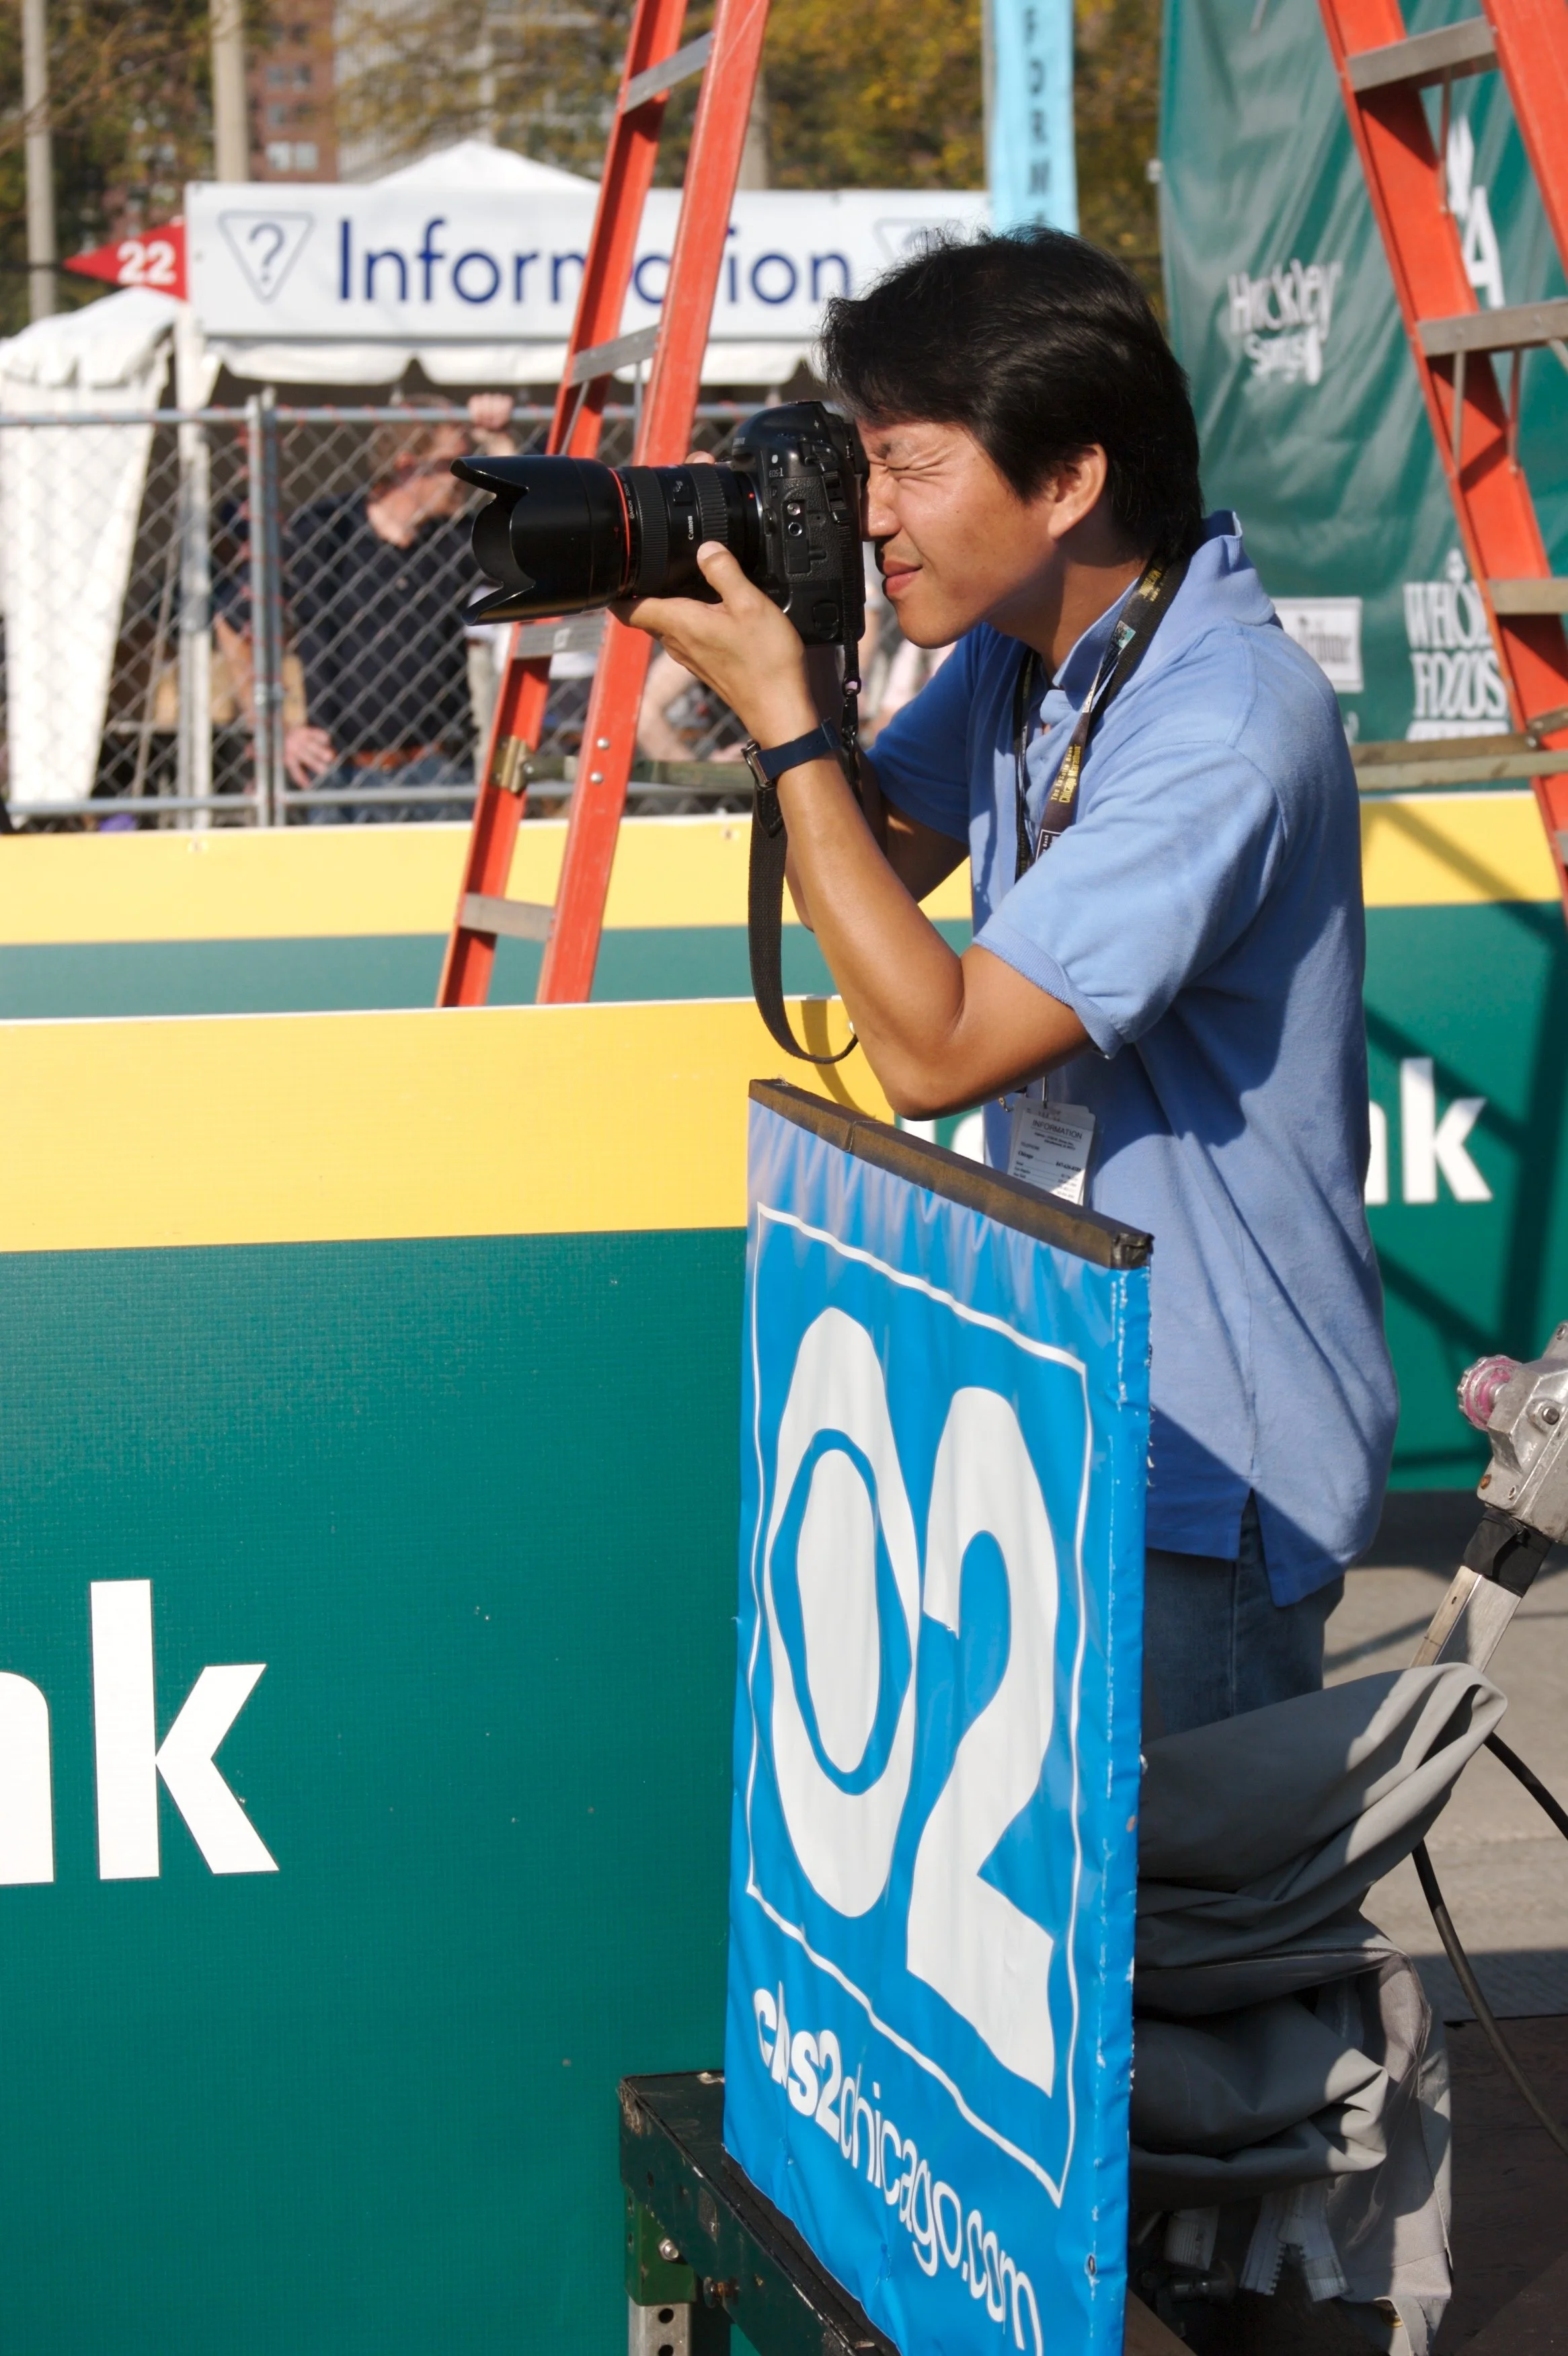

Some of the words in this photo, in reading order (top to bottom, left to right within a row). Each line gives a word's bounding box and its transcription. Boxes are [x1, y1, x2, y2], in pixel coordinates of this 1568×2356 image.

[117, 239, 176, 286] 22
[338, 217, 852, 306] Inforaion
[1402, 580, 1493, 649] WHOL
[1032, 1119, 1083, 1140] INFORMATION
